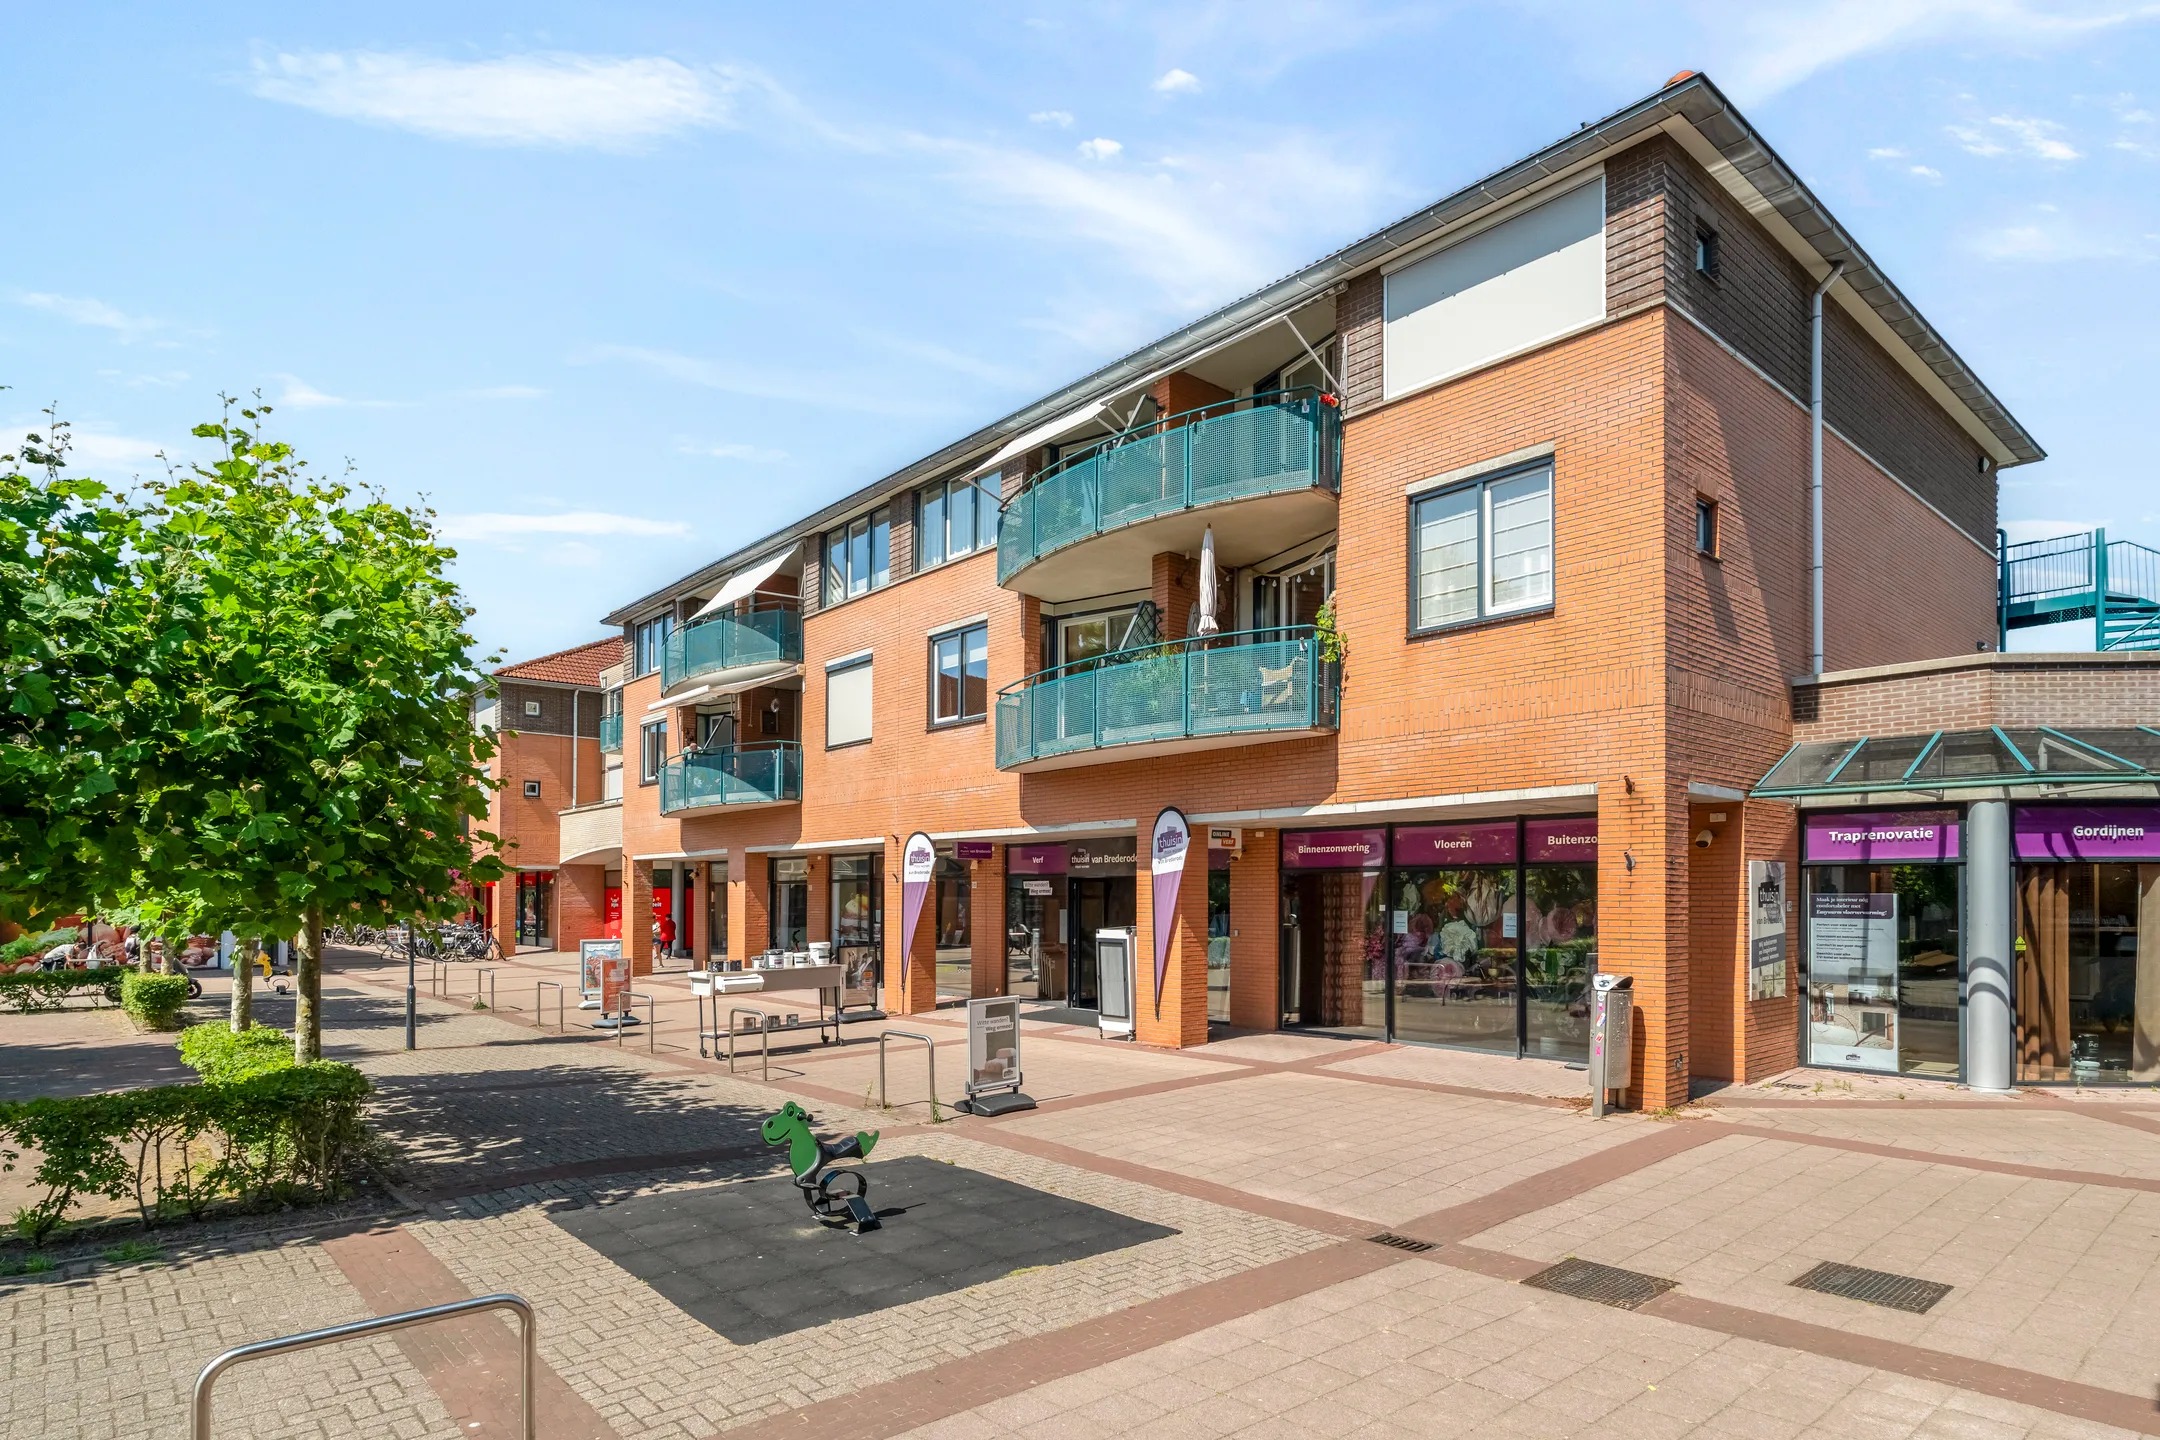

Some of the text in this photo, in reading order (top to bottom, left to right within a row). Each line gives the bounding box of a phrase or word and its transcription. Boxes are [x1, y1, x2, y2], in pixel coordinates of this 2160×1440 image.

[1829, 828, 1934, 843] Traprenovatie
[2073, 825, 2144, 839] Gordijnen
[1159, 835, 1183, 848] thuisin
[1434, 839, 1473, 849] Vloeren
[1547, 834, 1598, 845] Buitenzo
[1298, 843, 1370, 854] Binnenzonwering
[910, 854, 930, 863] thuisin
[1091, 856, 1103, 864] van
